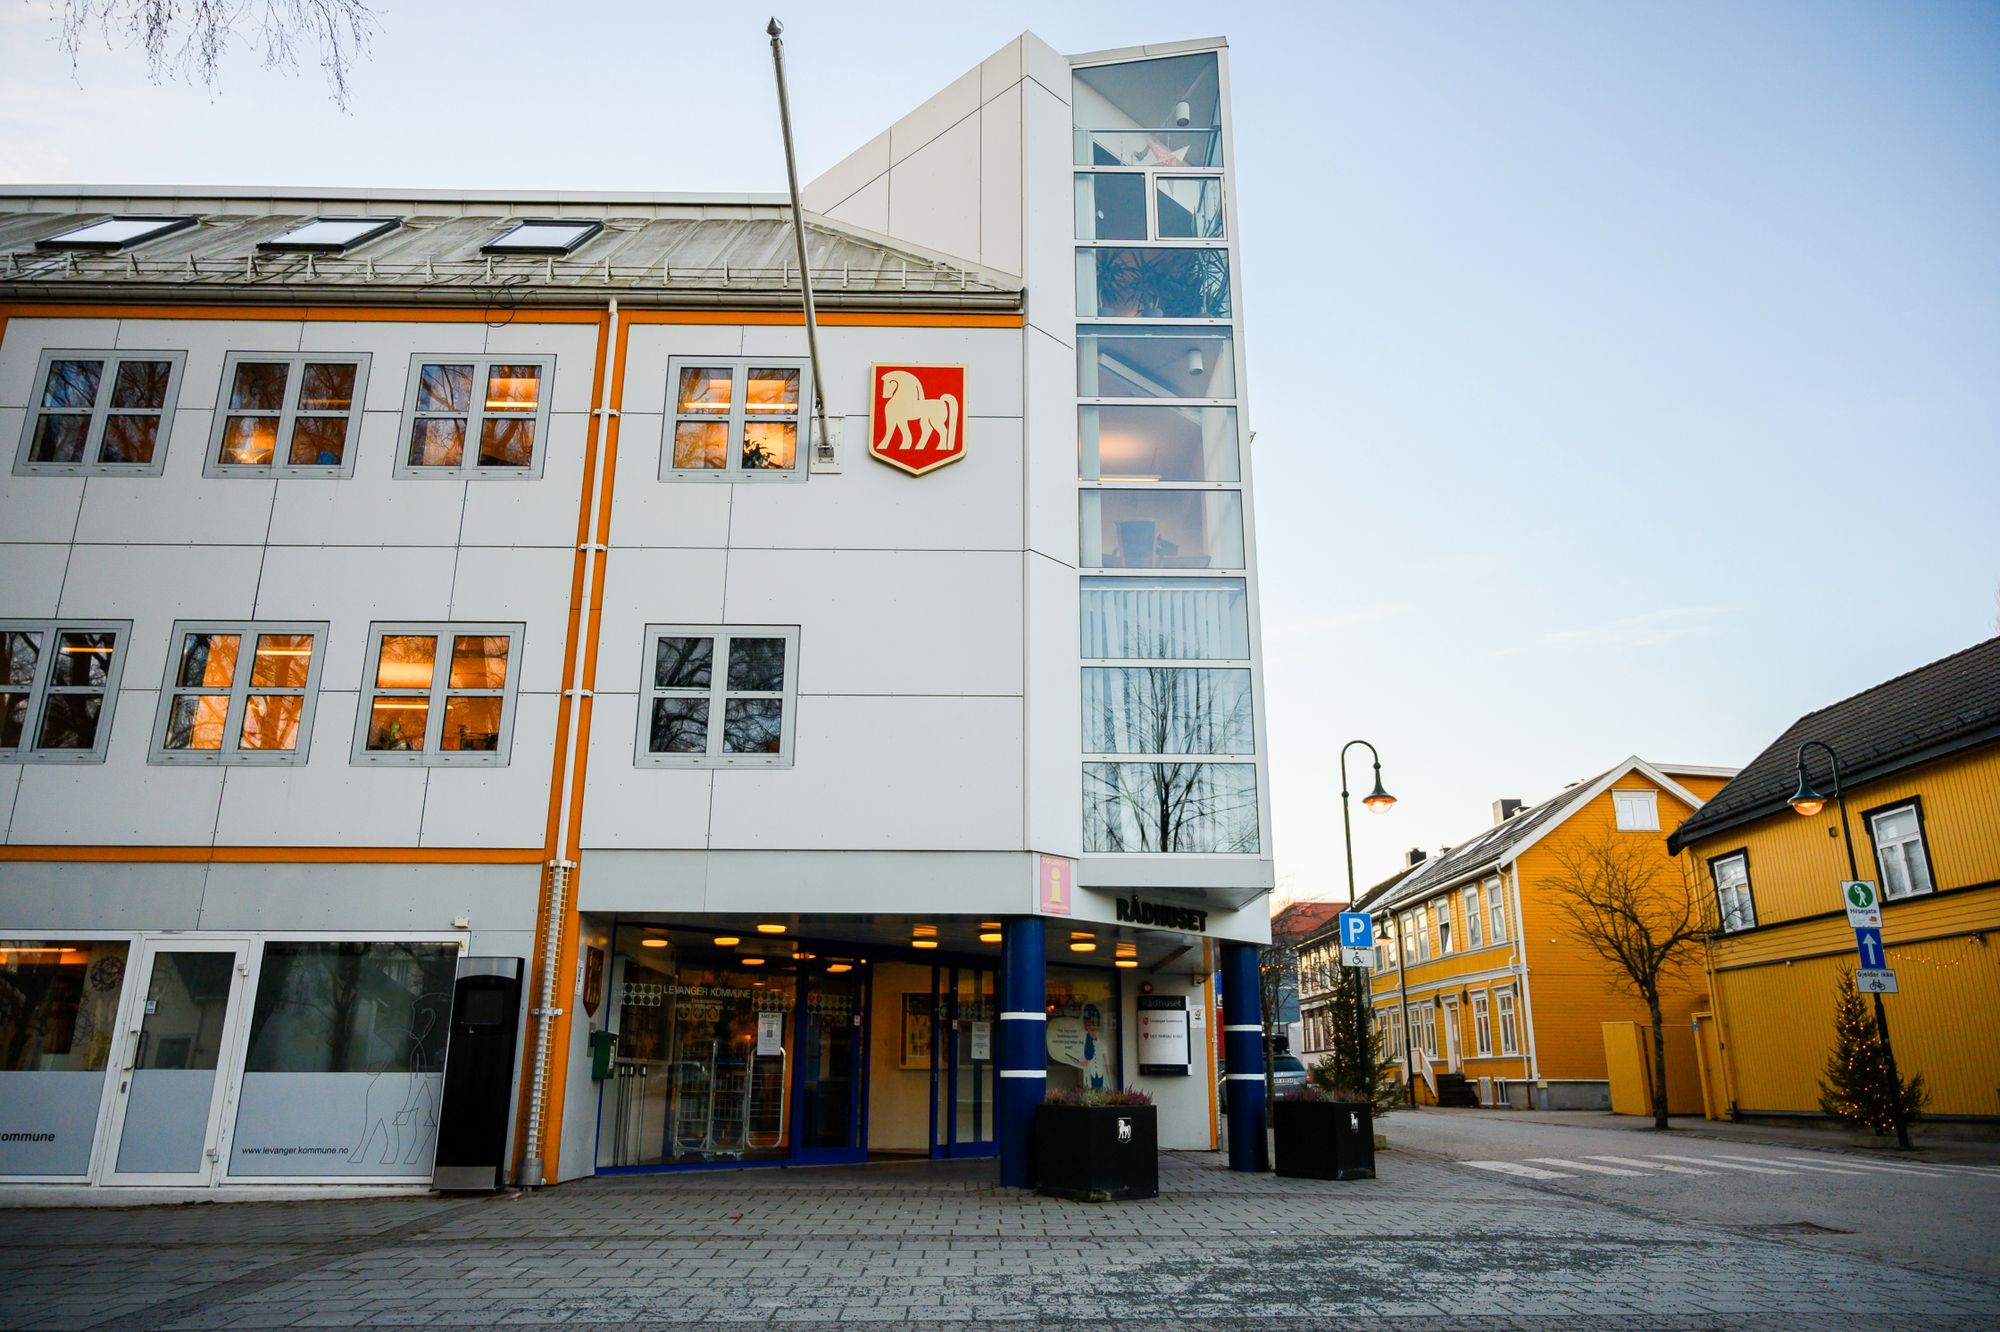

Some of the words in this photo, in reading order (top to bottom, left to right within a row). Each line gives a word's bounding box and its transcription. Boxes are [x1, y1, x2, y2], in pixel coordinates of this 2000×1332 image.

[1116, 895, 1208, 931] RÅDHUSET
[1348, 918, 1365, 943] P
[663, 984, 708, 996] LEVANGER
[710, 987, 751, 999] KOMMUNE
[0, 1132, 56, 1142] ommune
[242, 1146, 349, 1156] www.levanger.kommune.no
